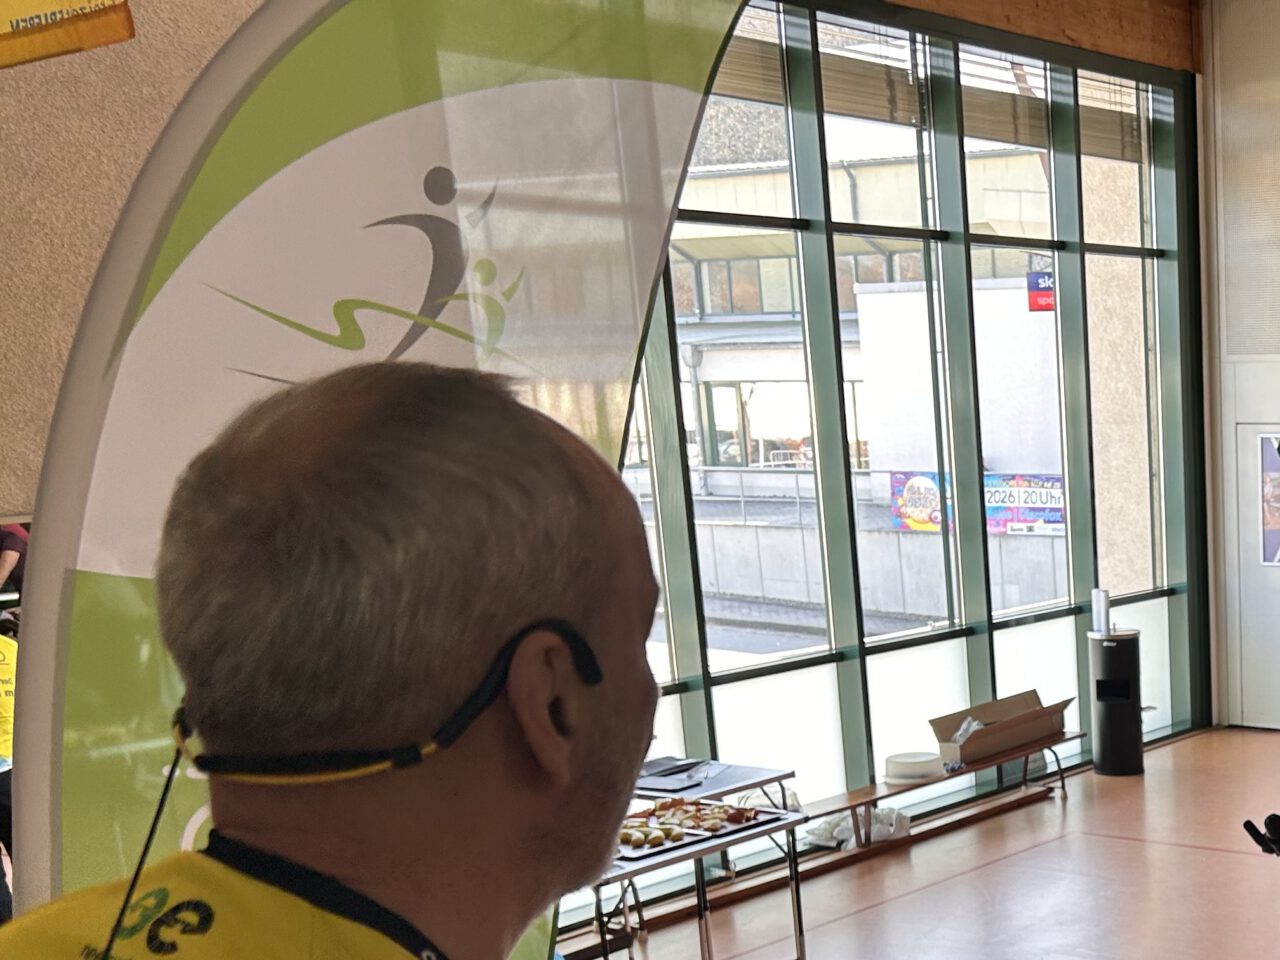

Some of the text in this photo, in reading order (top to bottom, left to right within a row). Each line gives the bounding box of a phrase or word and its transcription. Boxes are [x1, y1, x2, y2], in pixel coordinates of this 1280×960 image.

[1037, 275, 1054, 288] sk
[986, 489, 1062, 505] 2026 20 Uhr
